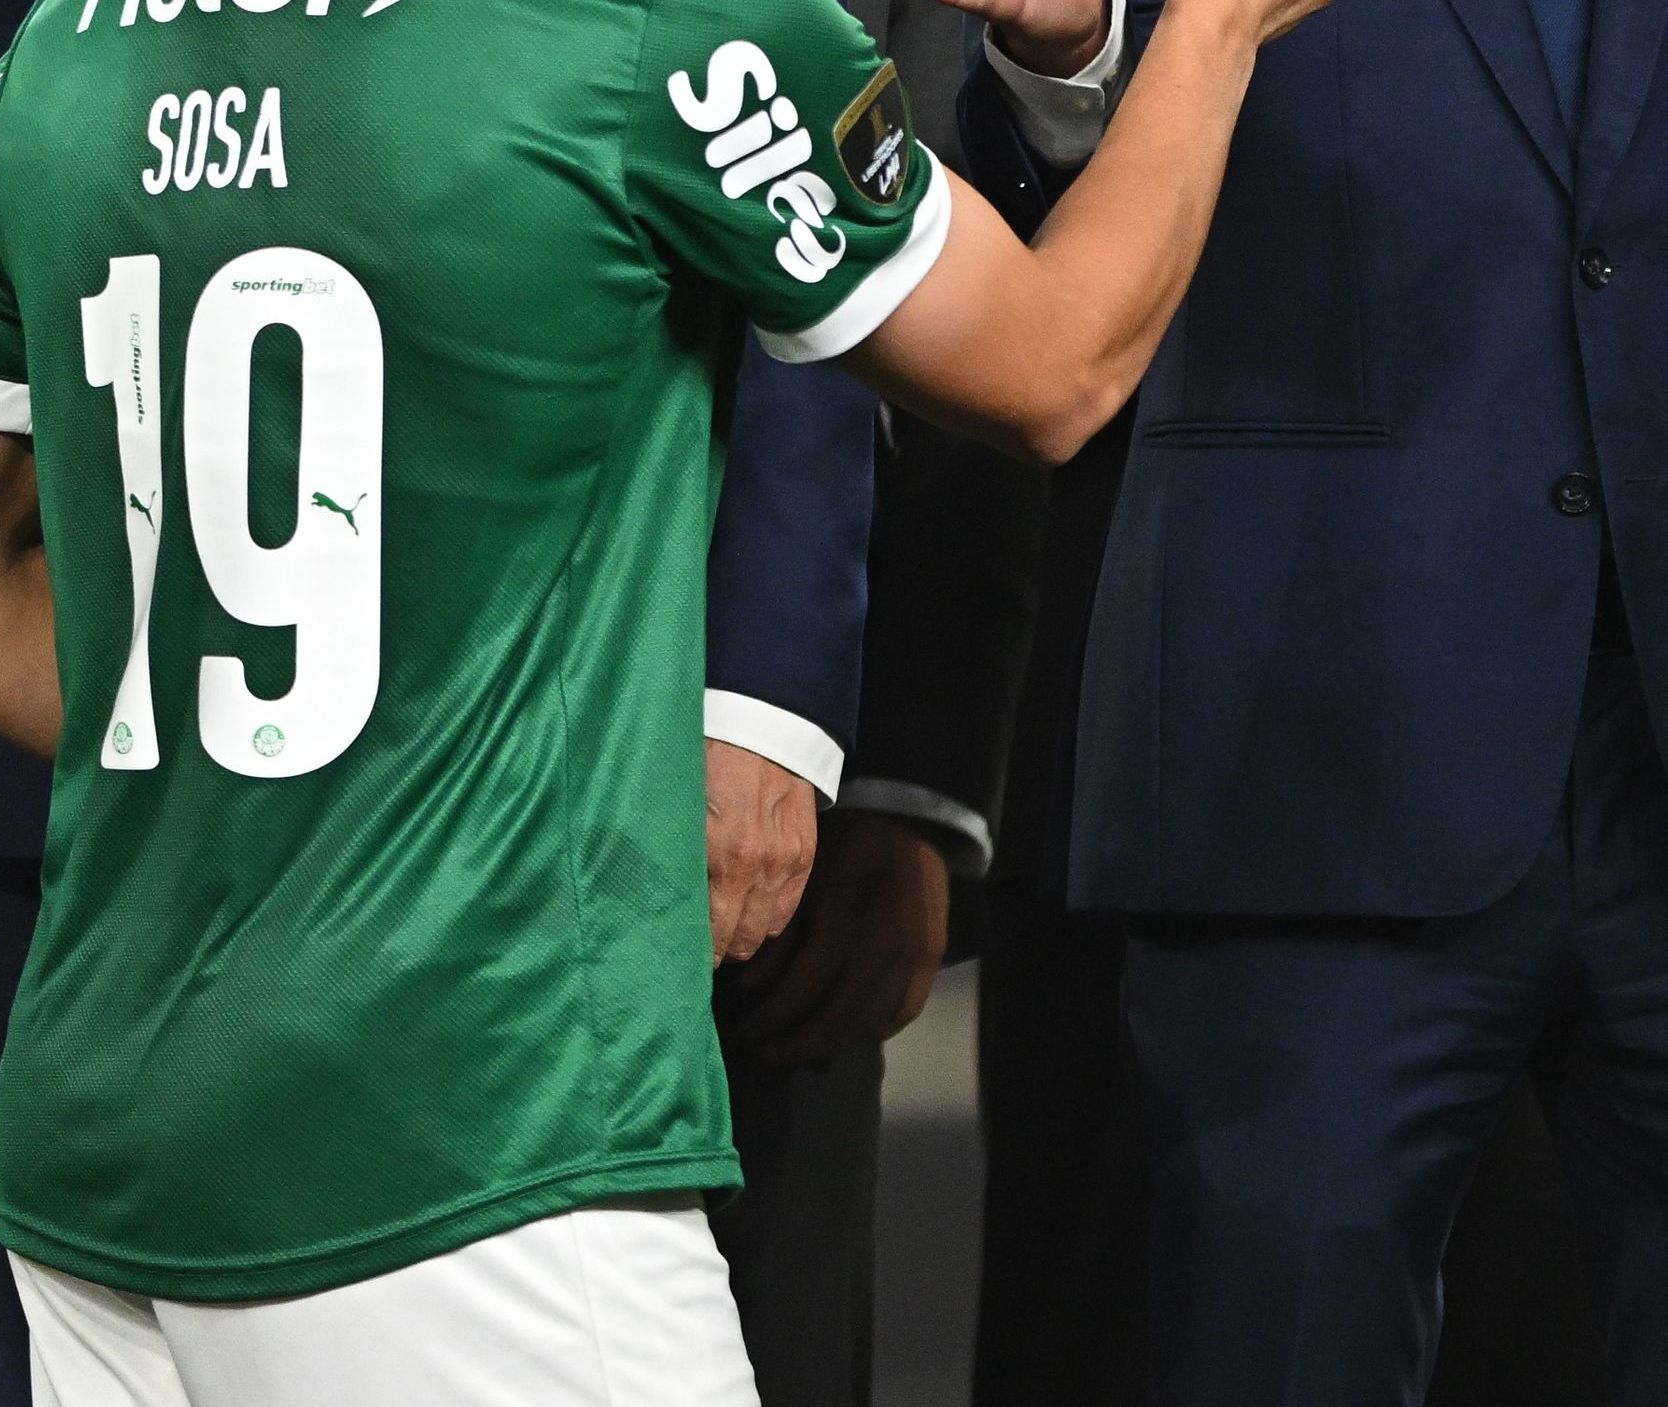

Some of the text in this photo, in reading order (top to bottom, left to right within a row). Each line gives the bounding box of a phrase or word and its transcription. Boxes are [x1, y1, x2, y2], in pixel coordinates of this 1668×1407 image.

[142, 86, 289, 195] SOSA
[231, 277, 337, 296] sportingbet
[129, 312, 146, 426] sportingbet
[80, 246, 384, 779] 19
